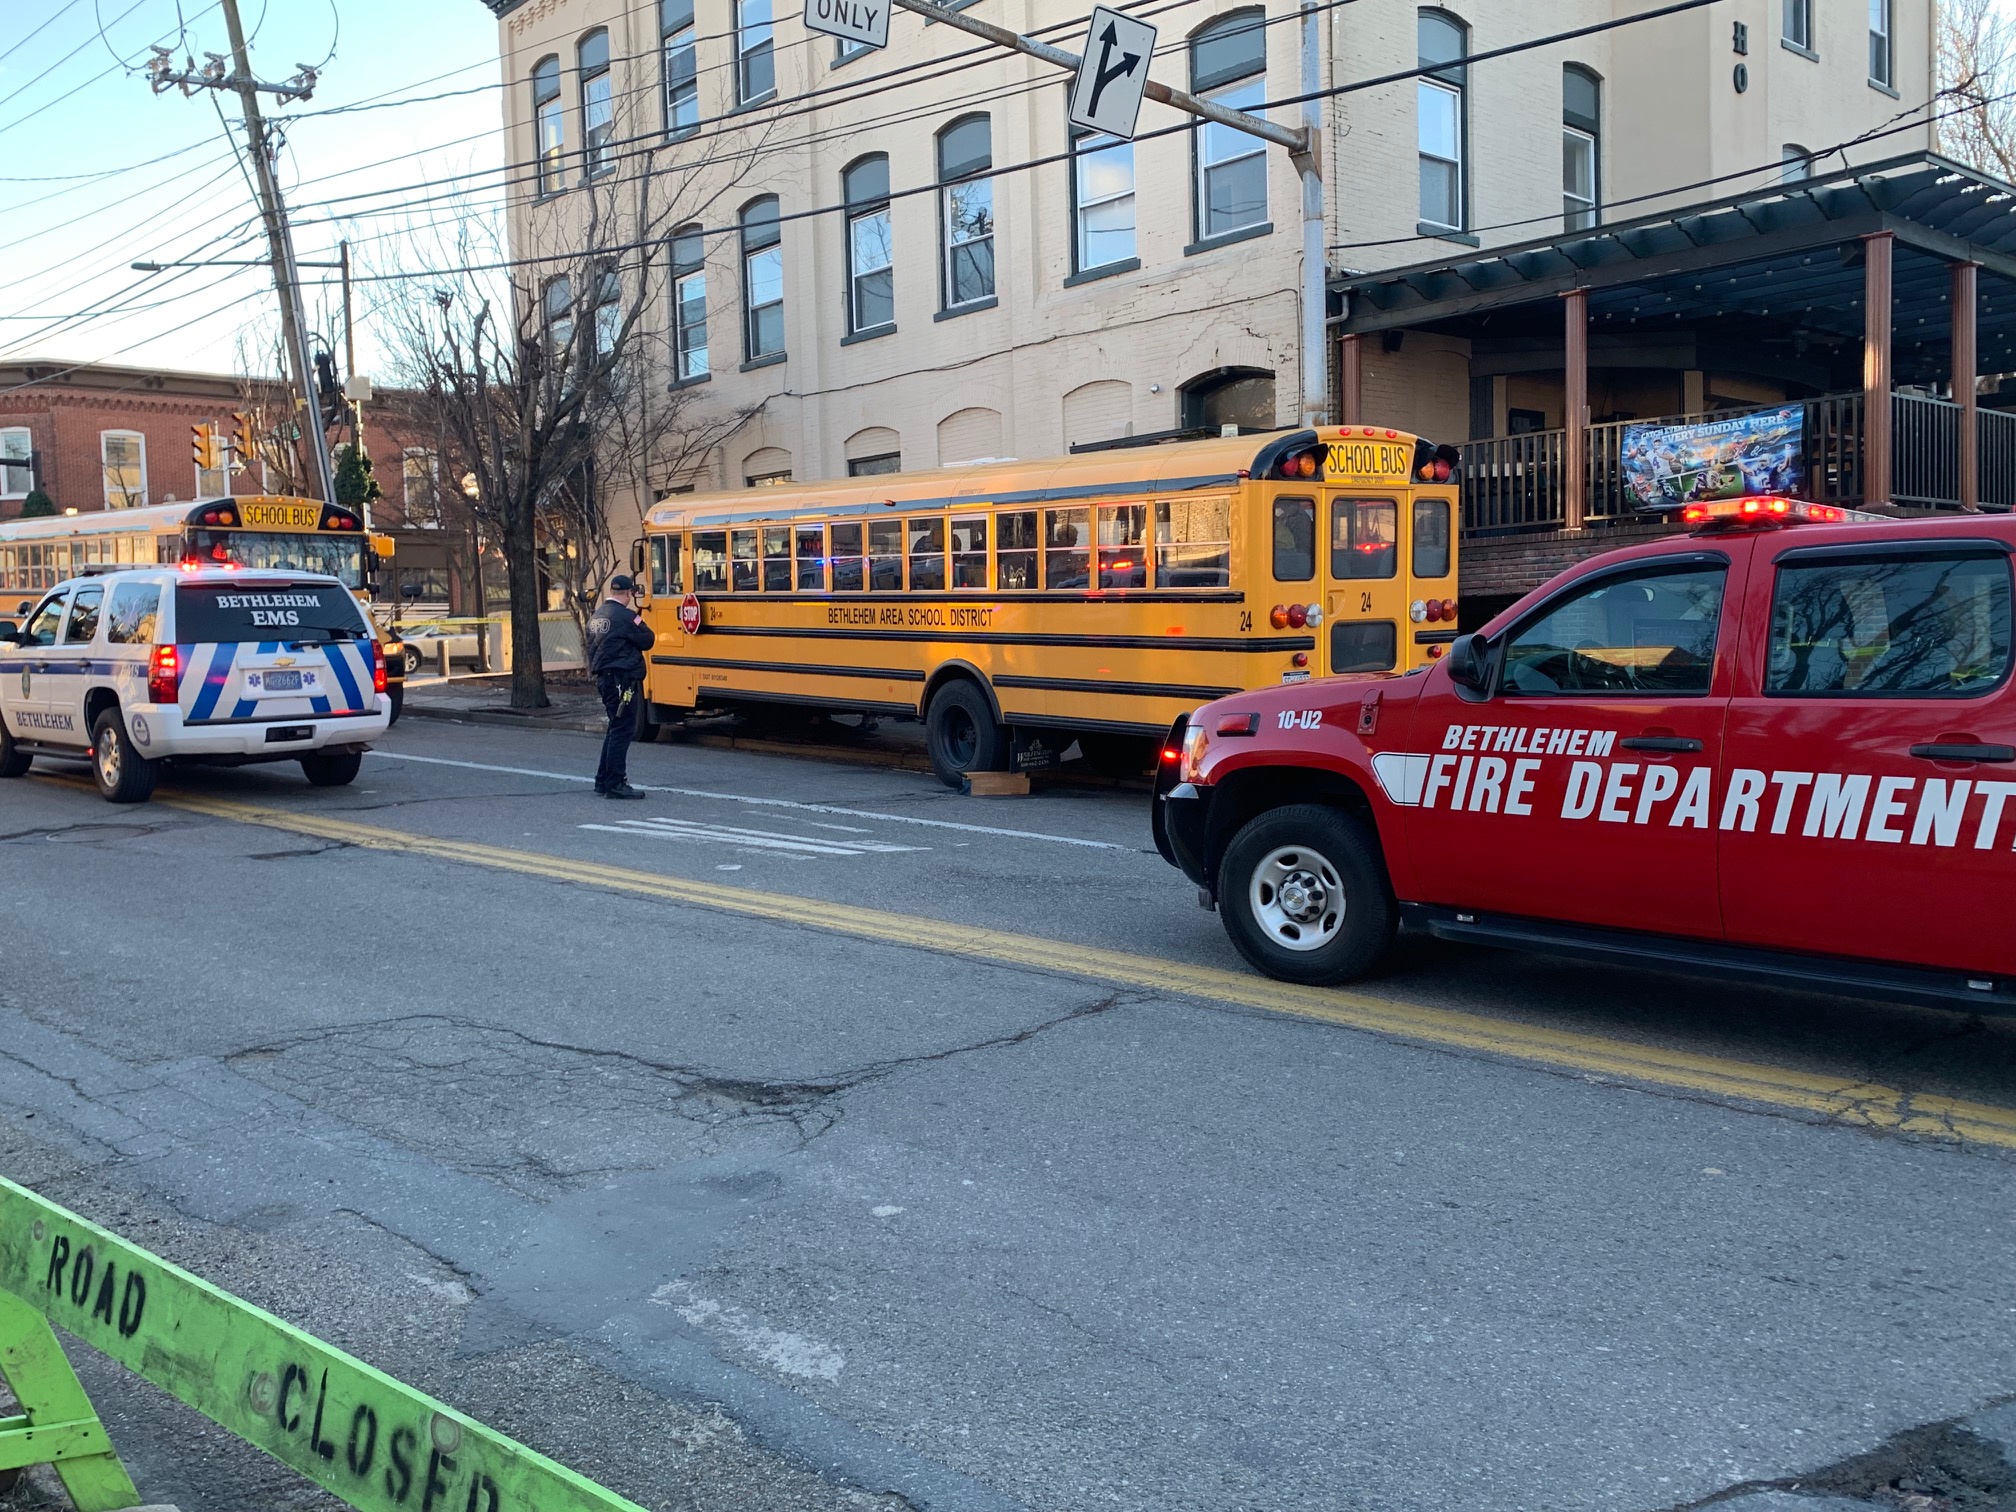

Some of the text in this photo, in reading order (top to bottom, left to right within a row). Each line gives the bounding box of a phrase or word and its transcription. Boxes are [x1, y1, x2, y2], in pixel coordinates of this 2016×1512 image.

[817, 0, 879, 32] ONLY
[1661, 430, 1696, 444] EVERY
[1697, 420, 1747, 437] SUNDAY
[1328, 444, 1406, 474] SCHOOL BUS
[1652, 456, 1660, 469] 4
[246, 505, 314, 526] SCHOOL BUS
[216, 594, 321, 609] BETHLEHEM
[1361, 592, 1371, 612] 24
[250, 610, 300, 626] EMS
[683, 606, 697, 621] STOP
[828, 608, 993, 627] BETHLEHEM AREA SCHOOL DISTRICT
[1240, 610, 1252, 632] 24
[16, 711, 74, 731] BETHLEHEM
[1277, 710, 1323, 730] 10-U2
[1441, 725, 1617, 757] BETHLEHEM
[1422, 754, 2016, 850] FIRE DEPARTMENT
[46, 1235, 147, 1338] ROAD
